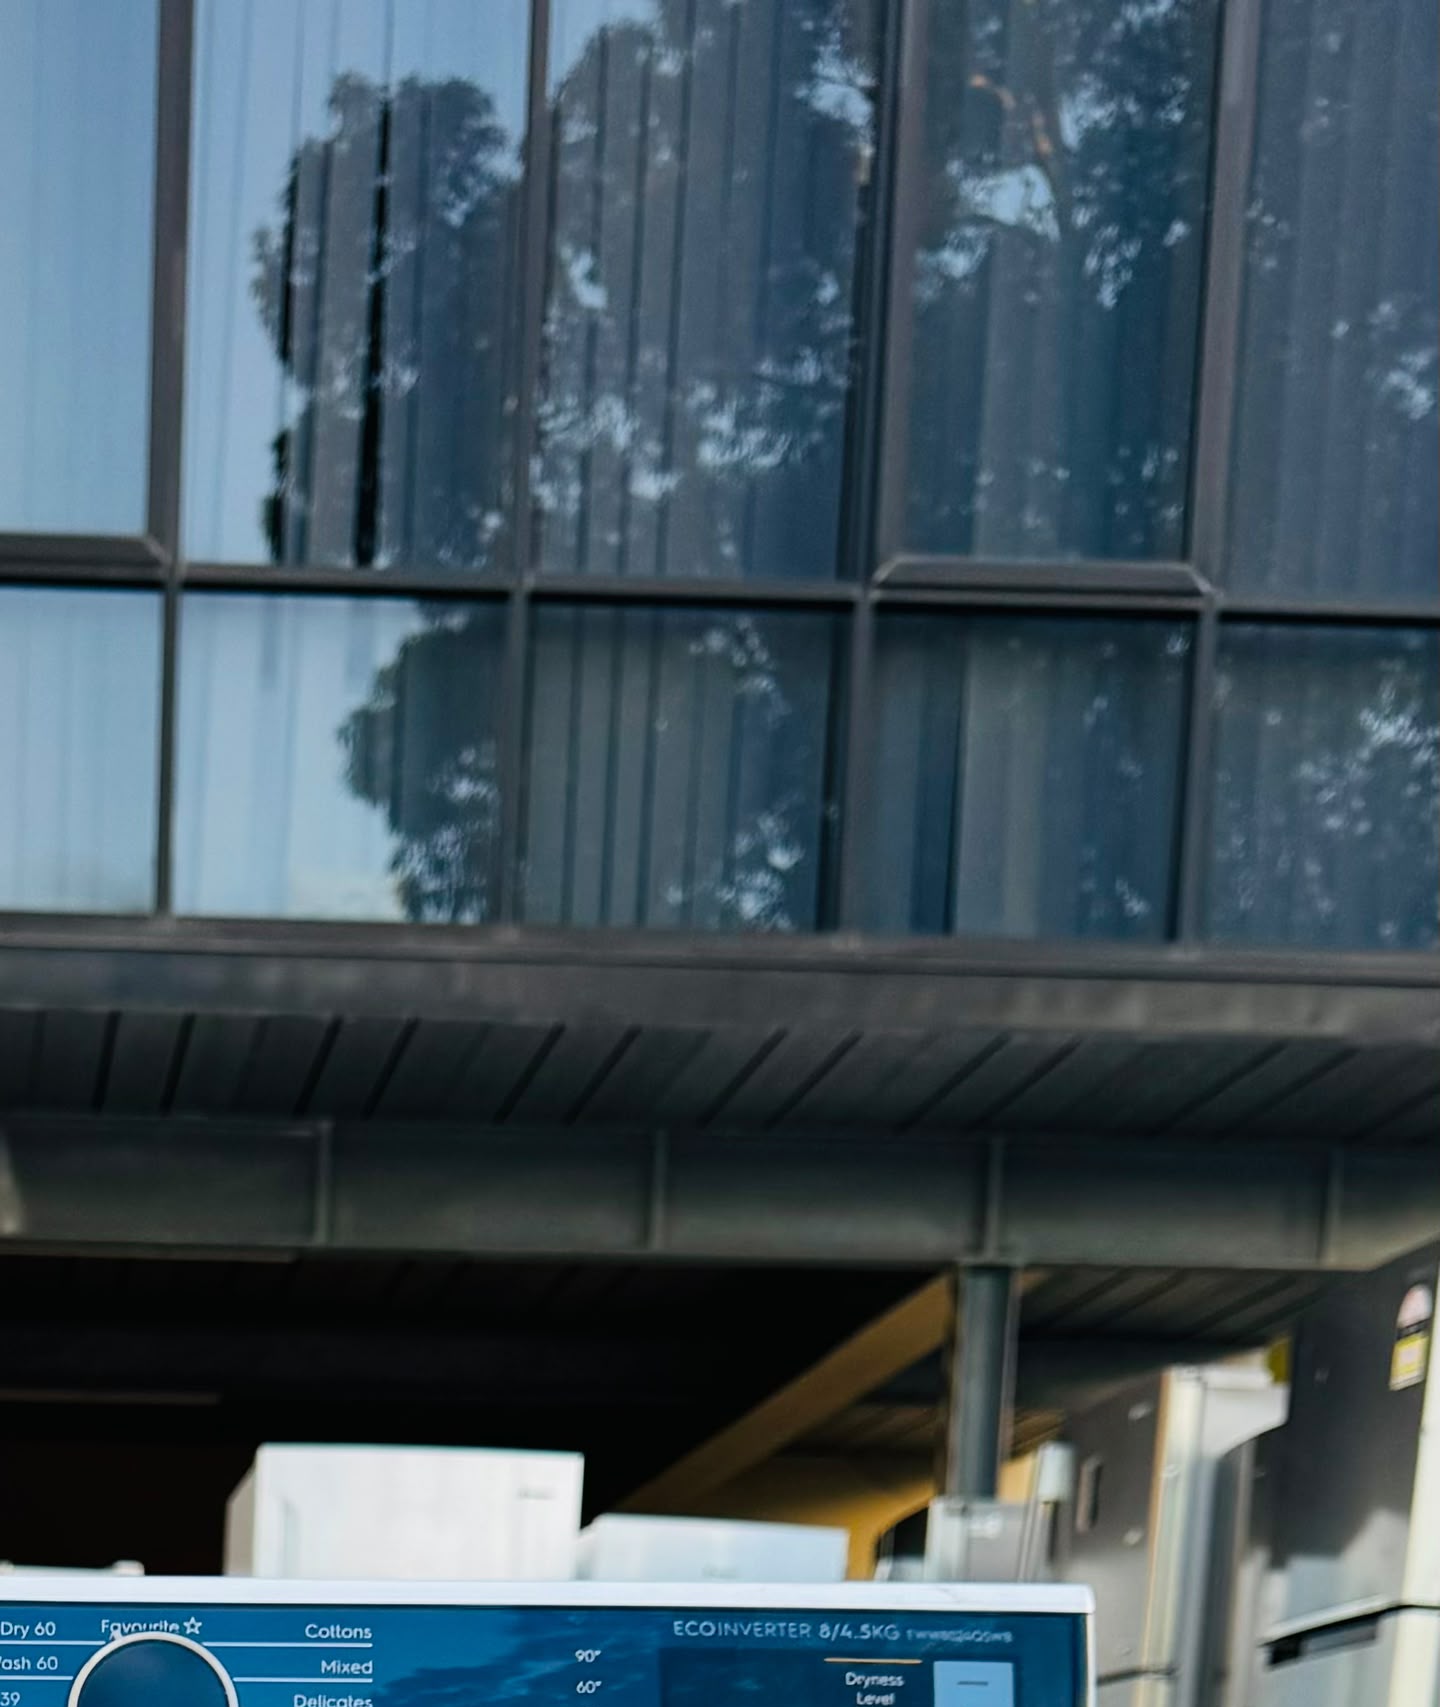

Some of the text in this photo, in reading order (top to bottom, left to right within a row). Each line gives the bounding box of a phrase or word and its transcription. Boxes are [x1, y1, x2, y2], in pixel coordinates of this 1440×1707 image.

[35, 1622, 56, 1636] 60
[305, 1623, 373, 1640] Cottons
[673, 1620, 811, 1638] ECOINVERTER
[818, 1624, 901, 1641] 8/4.5KG
[36, 1656, 59, 1671] 60
[320, 1659, 373, 1675] Mixed
[844, 1672, 906, 1689] Dryness
[0, 1692, 21, 1706] 39
[856, 1692, 895, 1706] Level
